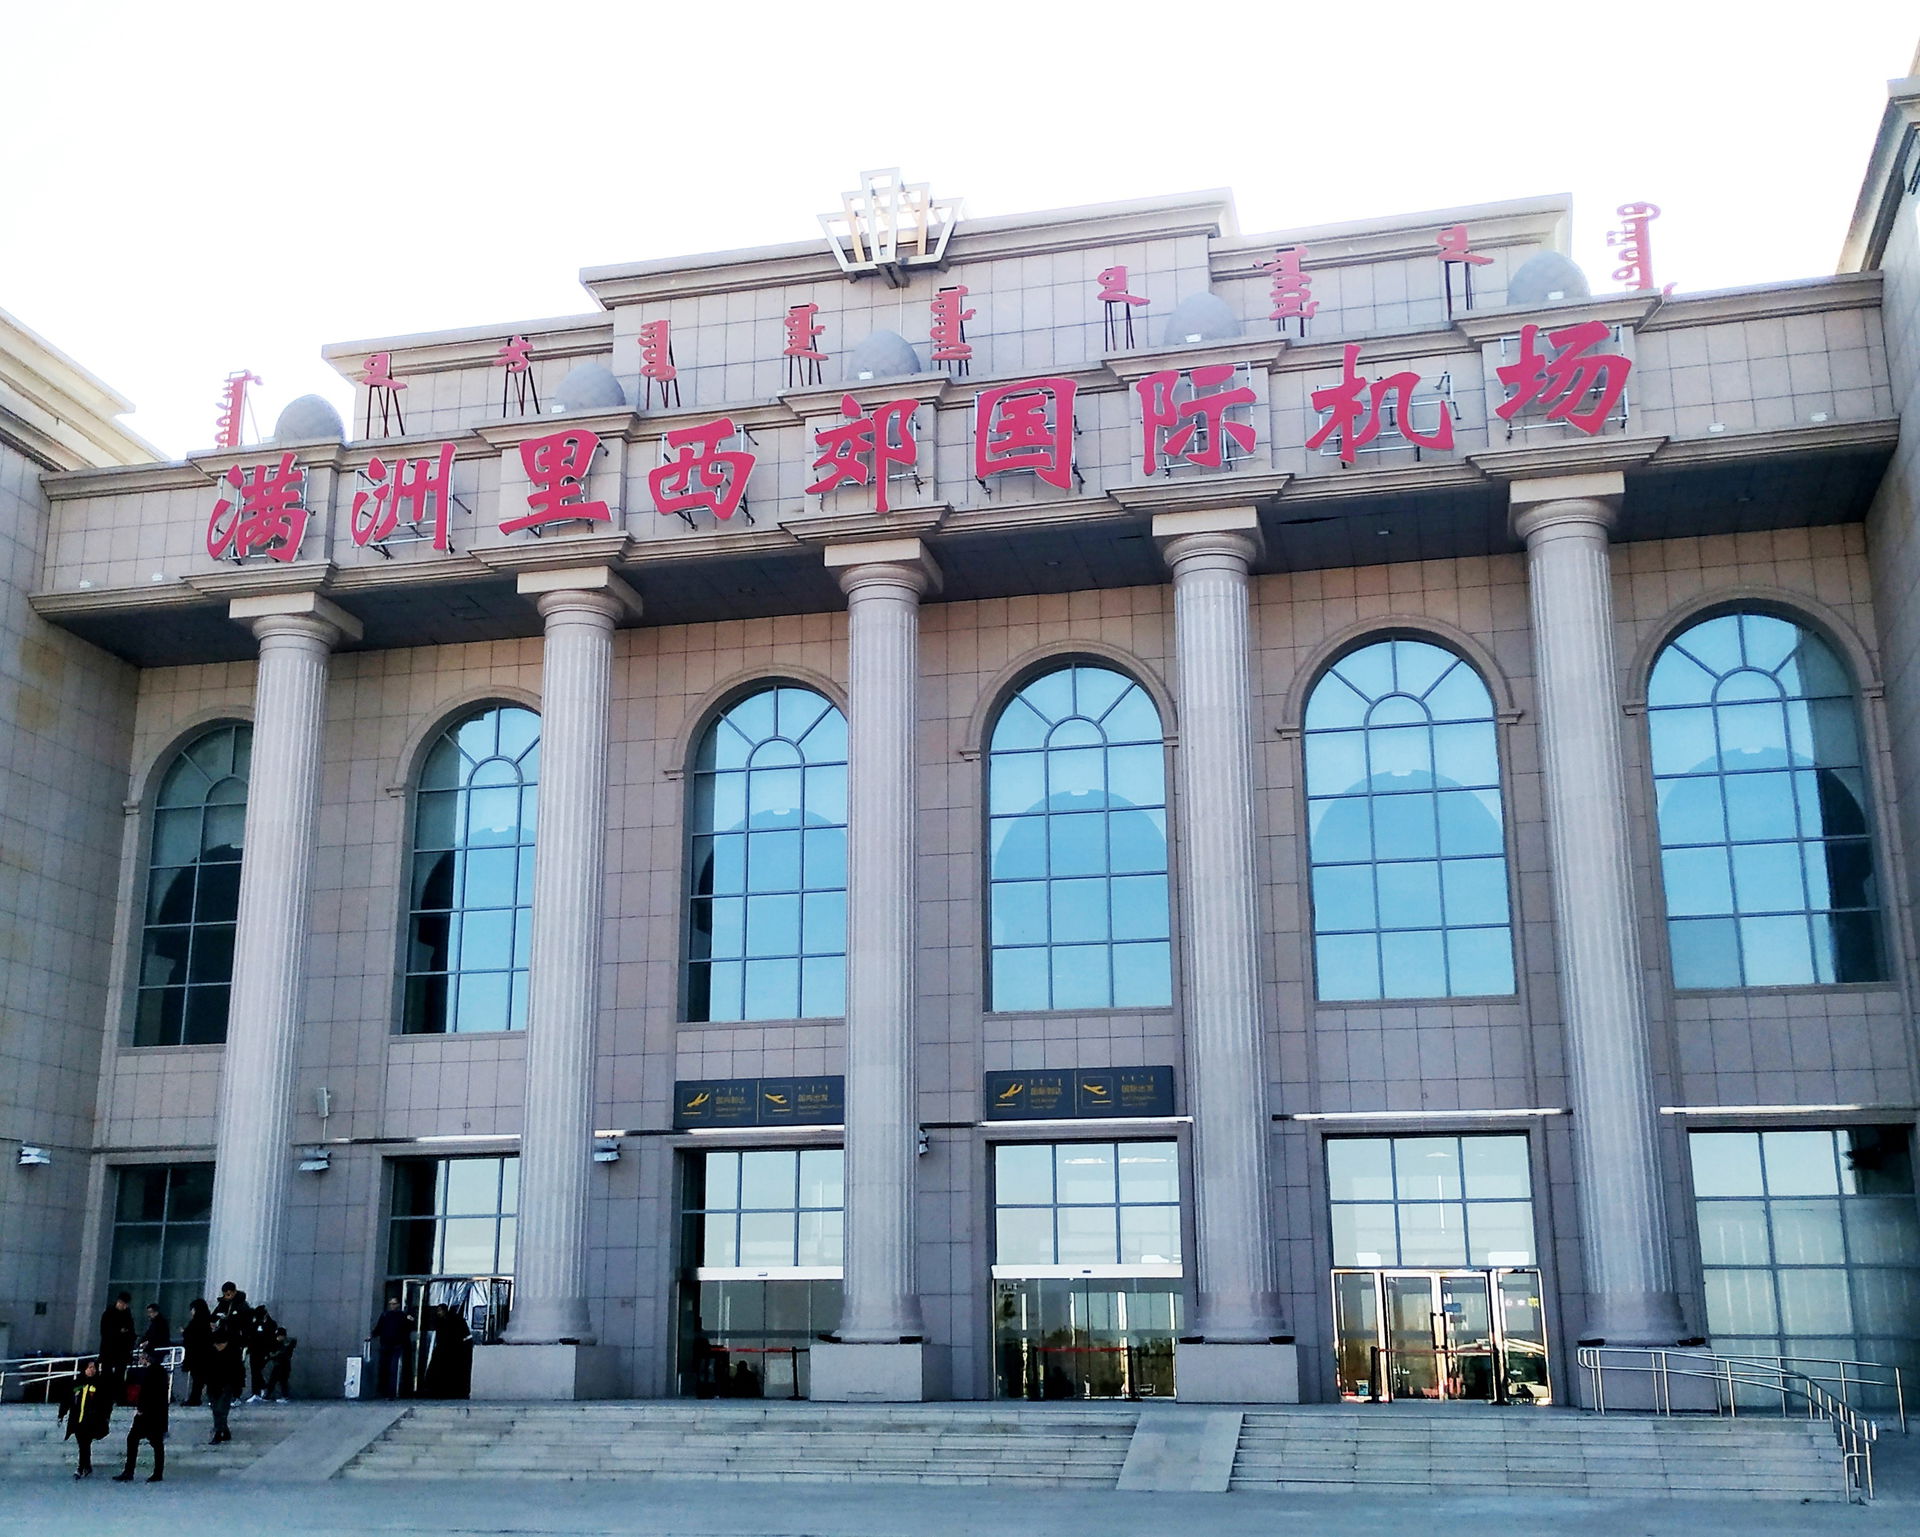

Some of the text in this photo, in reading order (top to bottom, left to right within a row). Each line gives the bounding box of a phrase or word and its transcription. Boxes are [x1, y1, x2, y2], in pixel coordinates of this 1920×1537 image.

[206, 320, 1632, 562] 满洲里西郊国际机场
